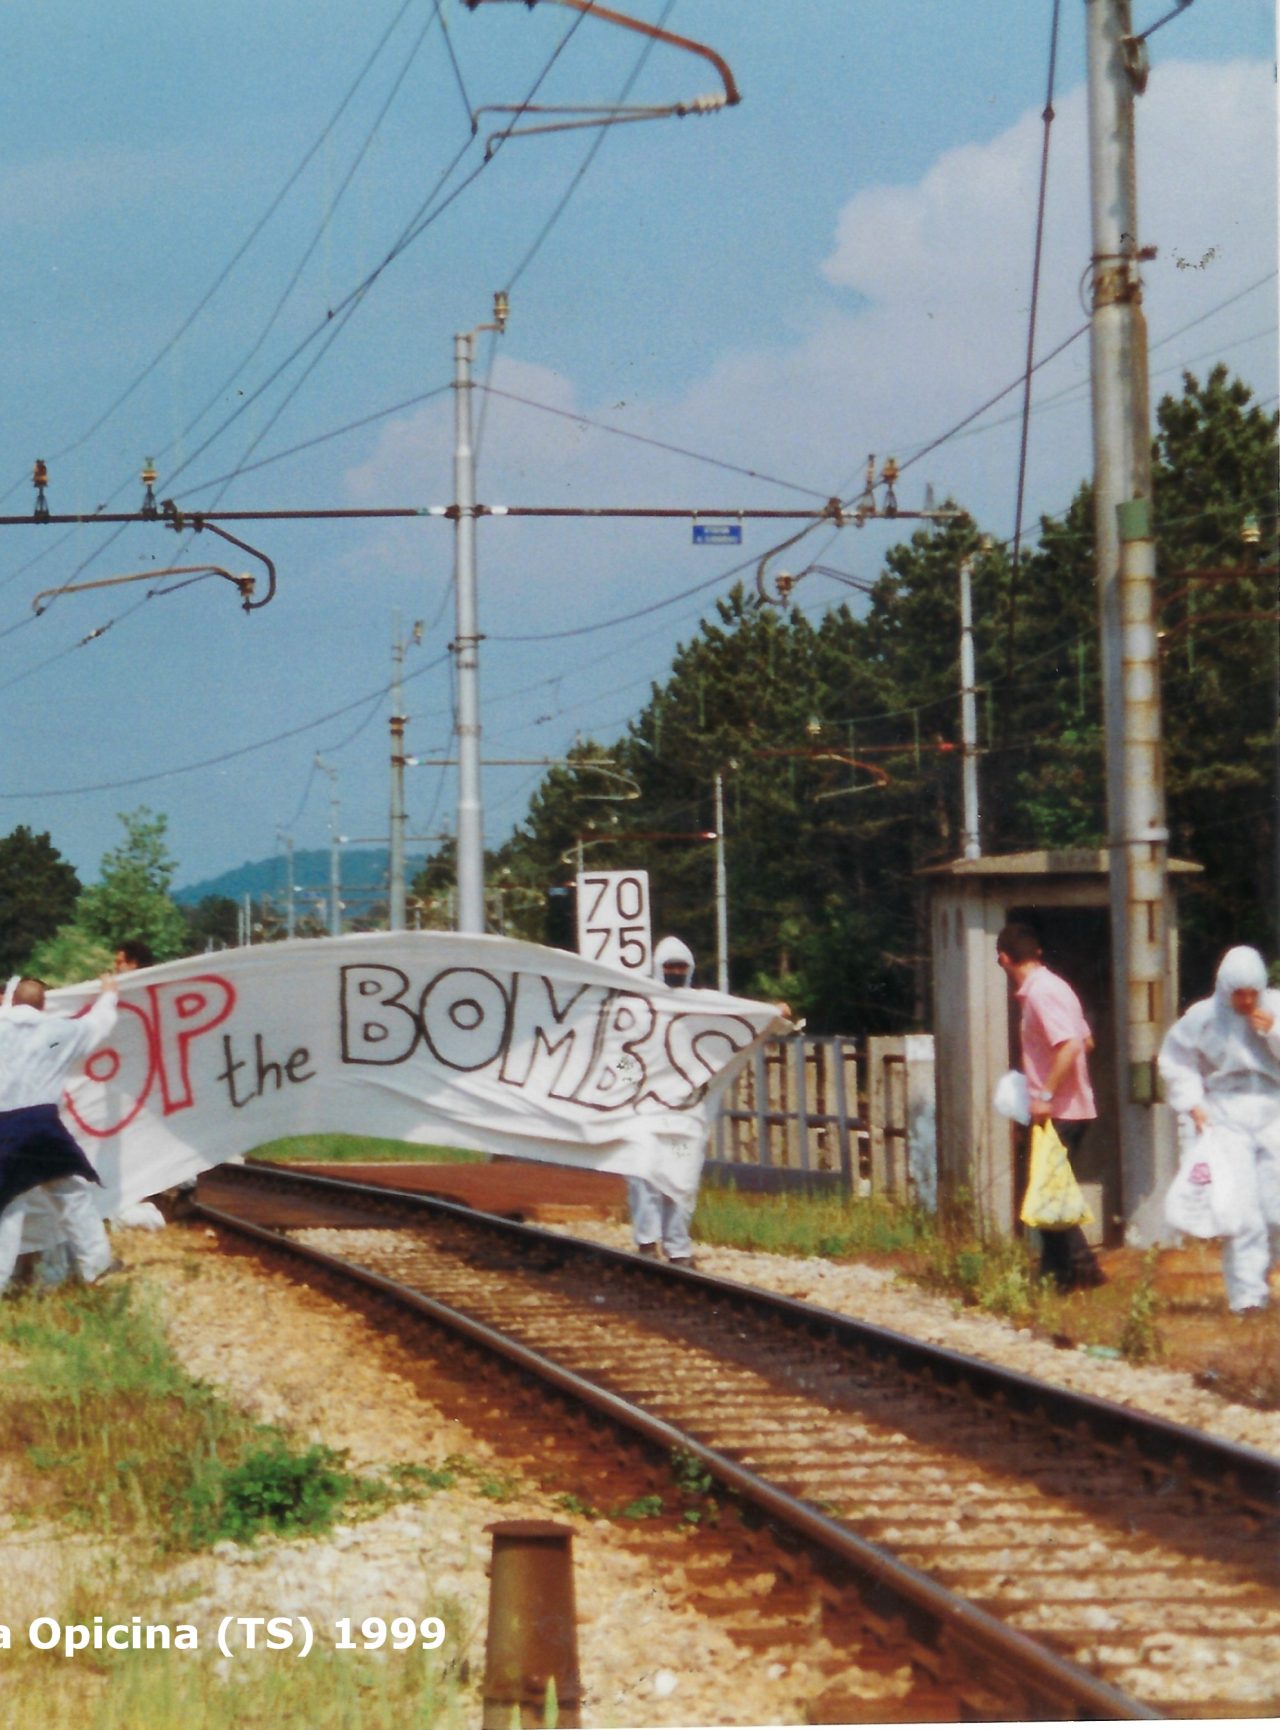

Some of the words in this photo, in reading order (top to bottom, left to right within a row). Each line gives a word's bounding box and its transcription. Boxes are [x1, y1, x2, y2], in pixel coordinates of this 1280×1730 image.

[584, 877, 644, 921] 70
[585, 926, 647, 969] 75
[215, 1033, 316, 1108] the
[340, 963, 759, 1112] BOMBS
